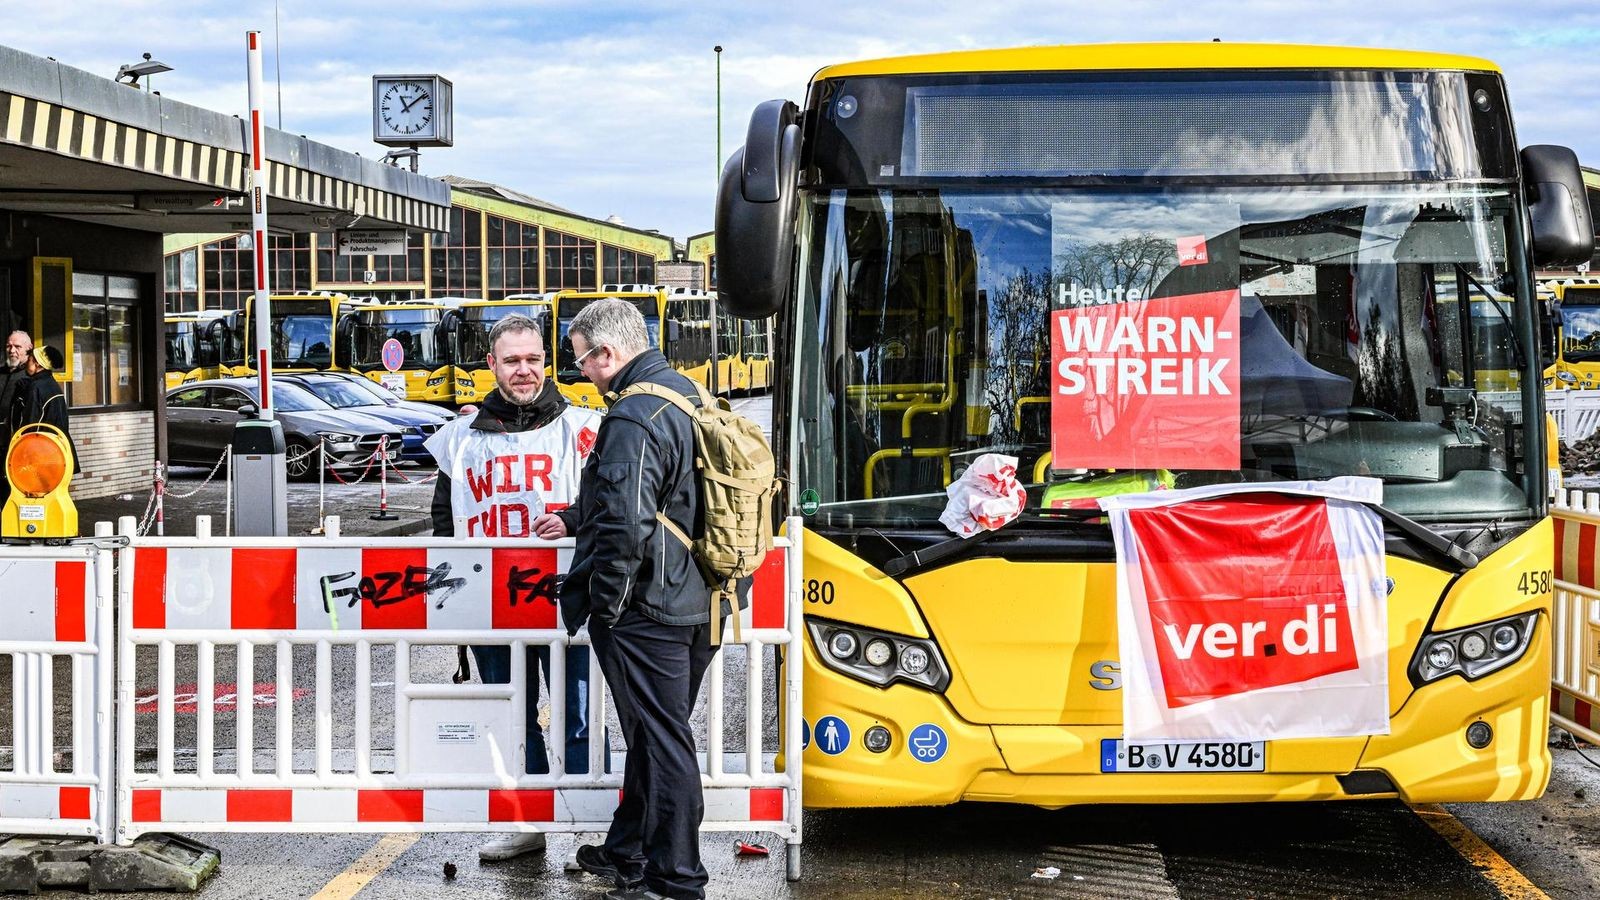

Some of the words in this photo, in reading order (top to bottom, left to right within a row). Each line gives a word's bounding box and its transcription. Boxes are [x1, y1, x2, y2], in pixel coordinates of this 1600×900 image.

[1180, 252, 1206, 261] ver.di
[1059, 283, 1143, 304] Heute
[1058, 316, 1232, 353] WARN-
[1058, 357, 1232, 395] STREIK
[466, 454, 553, 503] WIR
[802, 578, 835, 605] 80
[1517, 569, 1553, 595] 4580
[1163, 604, 1337, 661] ver.di
[1128, 745, 1145, 768] B
[1164, 744, 1181, 767] V
[1187, 742, 1253, 768] 4580
